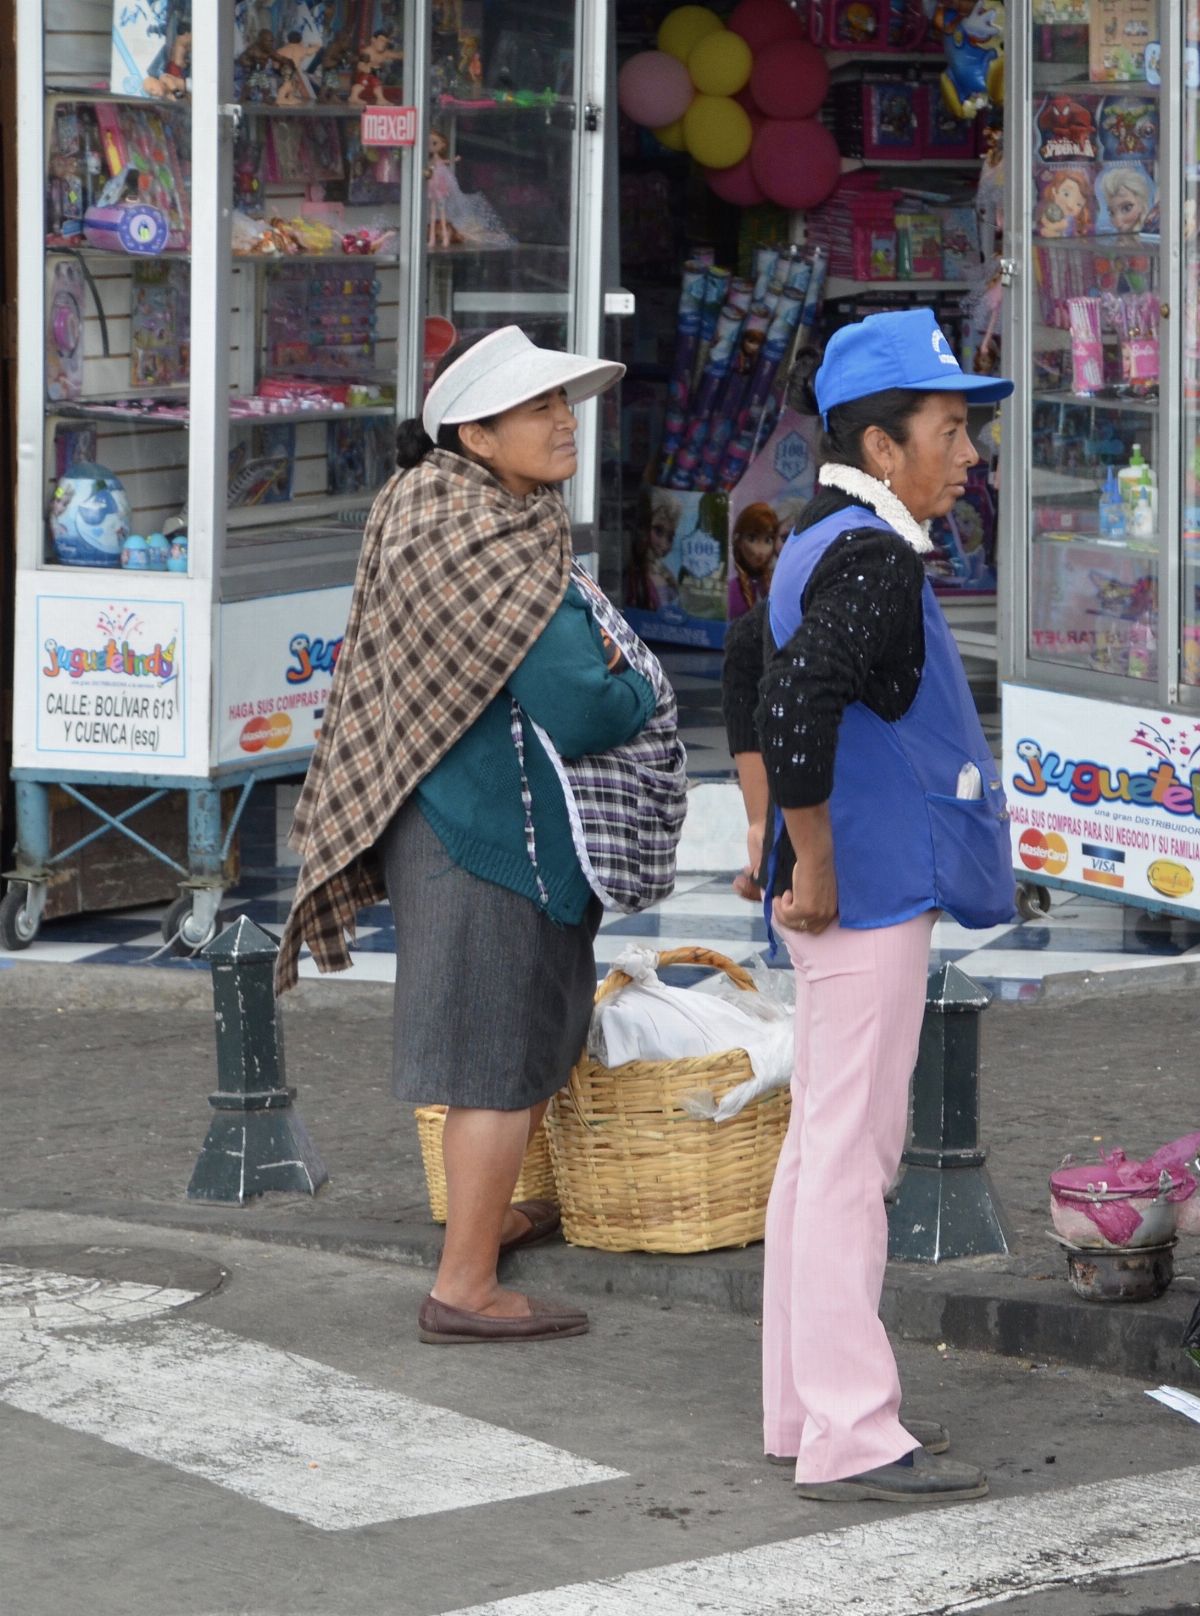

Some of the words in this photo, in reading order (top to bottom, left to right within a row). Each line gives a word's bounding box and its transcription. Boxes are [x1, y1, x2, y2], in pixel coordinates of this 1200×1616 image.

[364, 110, 415, 141] maxell
[688, 541, 714, 556] 100
[43, 637, 176, 678] juguetelindo
[46, 693, 91, 716] CALLE:
[95, 690, 150, 719] BOLÍVAR
[153, 699, 174, 721] 613
[229, 702, 255, 720] HAGA
[257, 698, 274, 715] SUS
[276, 690, 319, 711] COMPRAS
[64, 721, 72, 742] Y
[75, 721, 127, 745] CUENCA
[131, 724, 160, 752] (esq)
[1094, 809, 1110, 818] una
[1113, 813, 1132, 823] gran
[1010, 805, 1030, 825] HAGA
[1032, 810, 1045, 828] SUS
[1047, 814, 1082, 836] COMPRAS
[1084, 820, 1102, 841] PARA
[1105, 825, 1114, 843] SU
[1116, 827, 1149, 851] NEGOCIO
[1152, 834, 1157, 851] Y
[1159, 835, 1169, 855] SU
[1171, 838, 1200, 861] FAMILIA
[1092, 858, 1116, 873] VISA
